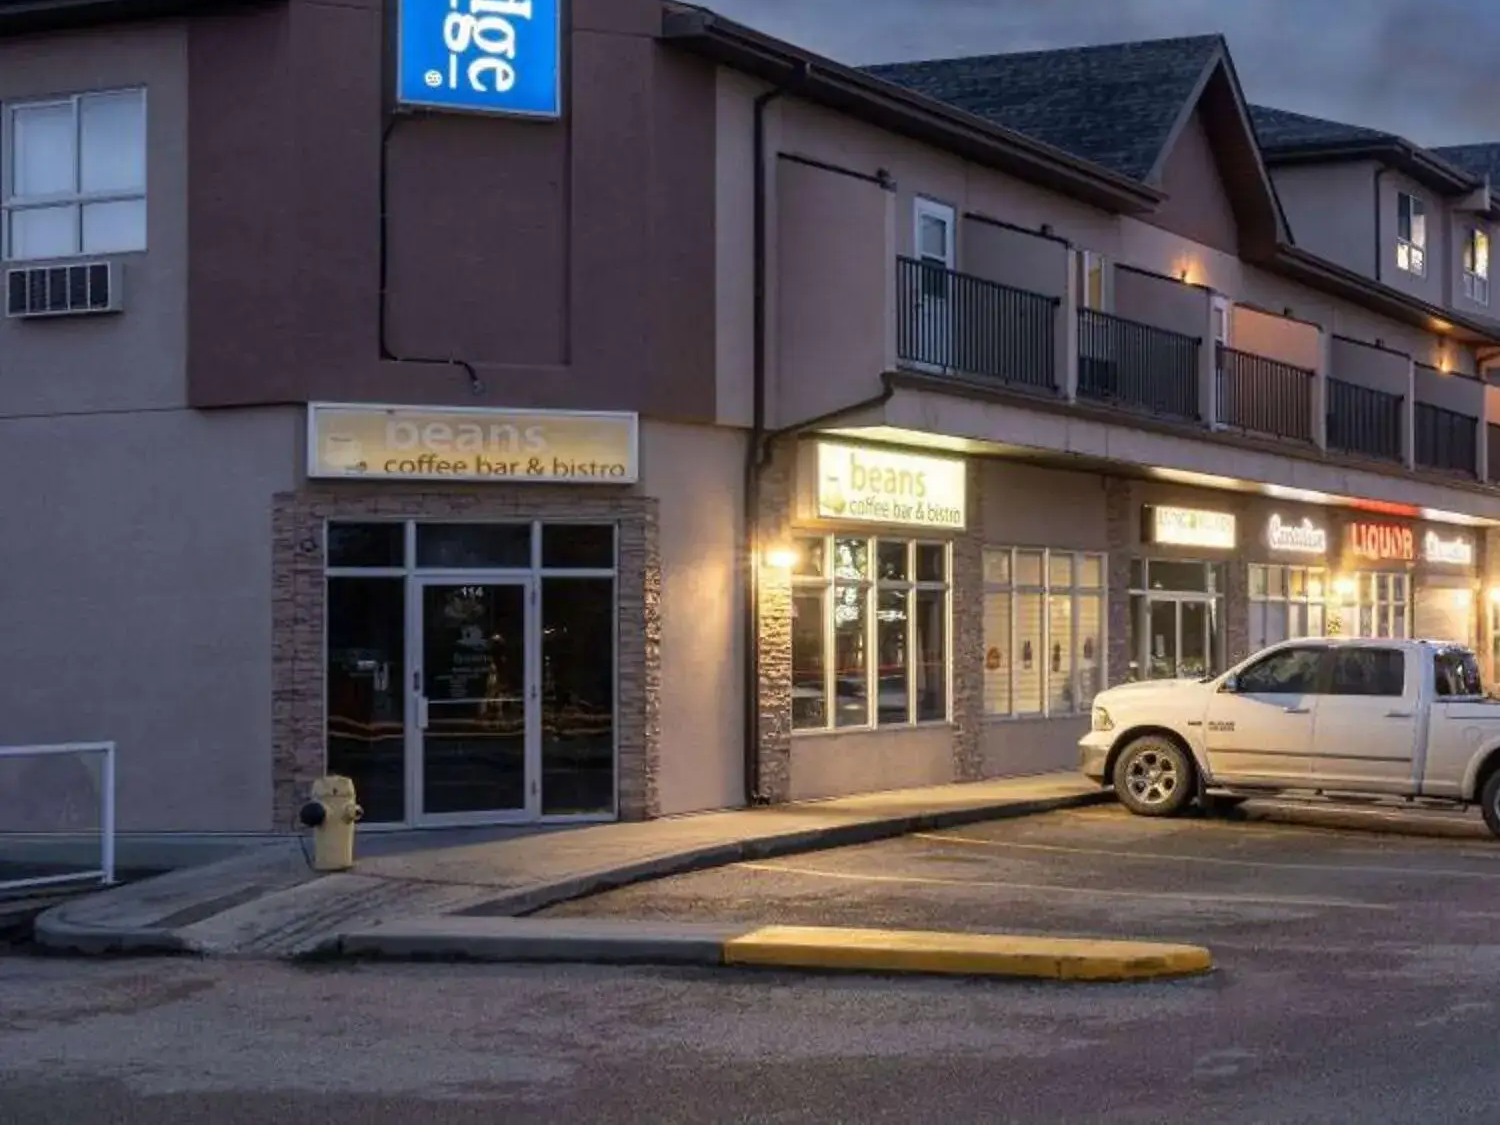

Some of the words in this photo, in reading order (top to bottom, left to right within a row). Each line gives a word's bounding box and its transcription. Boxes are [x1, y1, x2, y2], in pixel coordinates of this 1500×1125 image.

[385, 415, 549, 453] beans
[383, 454, 469, 475] coffee
[476, 455, 520, 476] bar
[526, 458, 546, 476] &
[553, 457, 625, 477] bistro
[850, 452, 927, 498] beans
[849, 497, 890, 518] coffee
[893, 500, 914, 521] bar
[915, 503, 925, 522] &
[927, 503, 961, 524] bistro
[1352, 522, 1413, 560] LIQUOR
